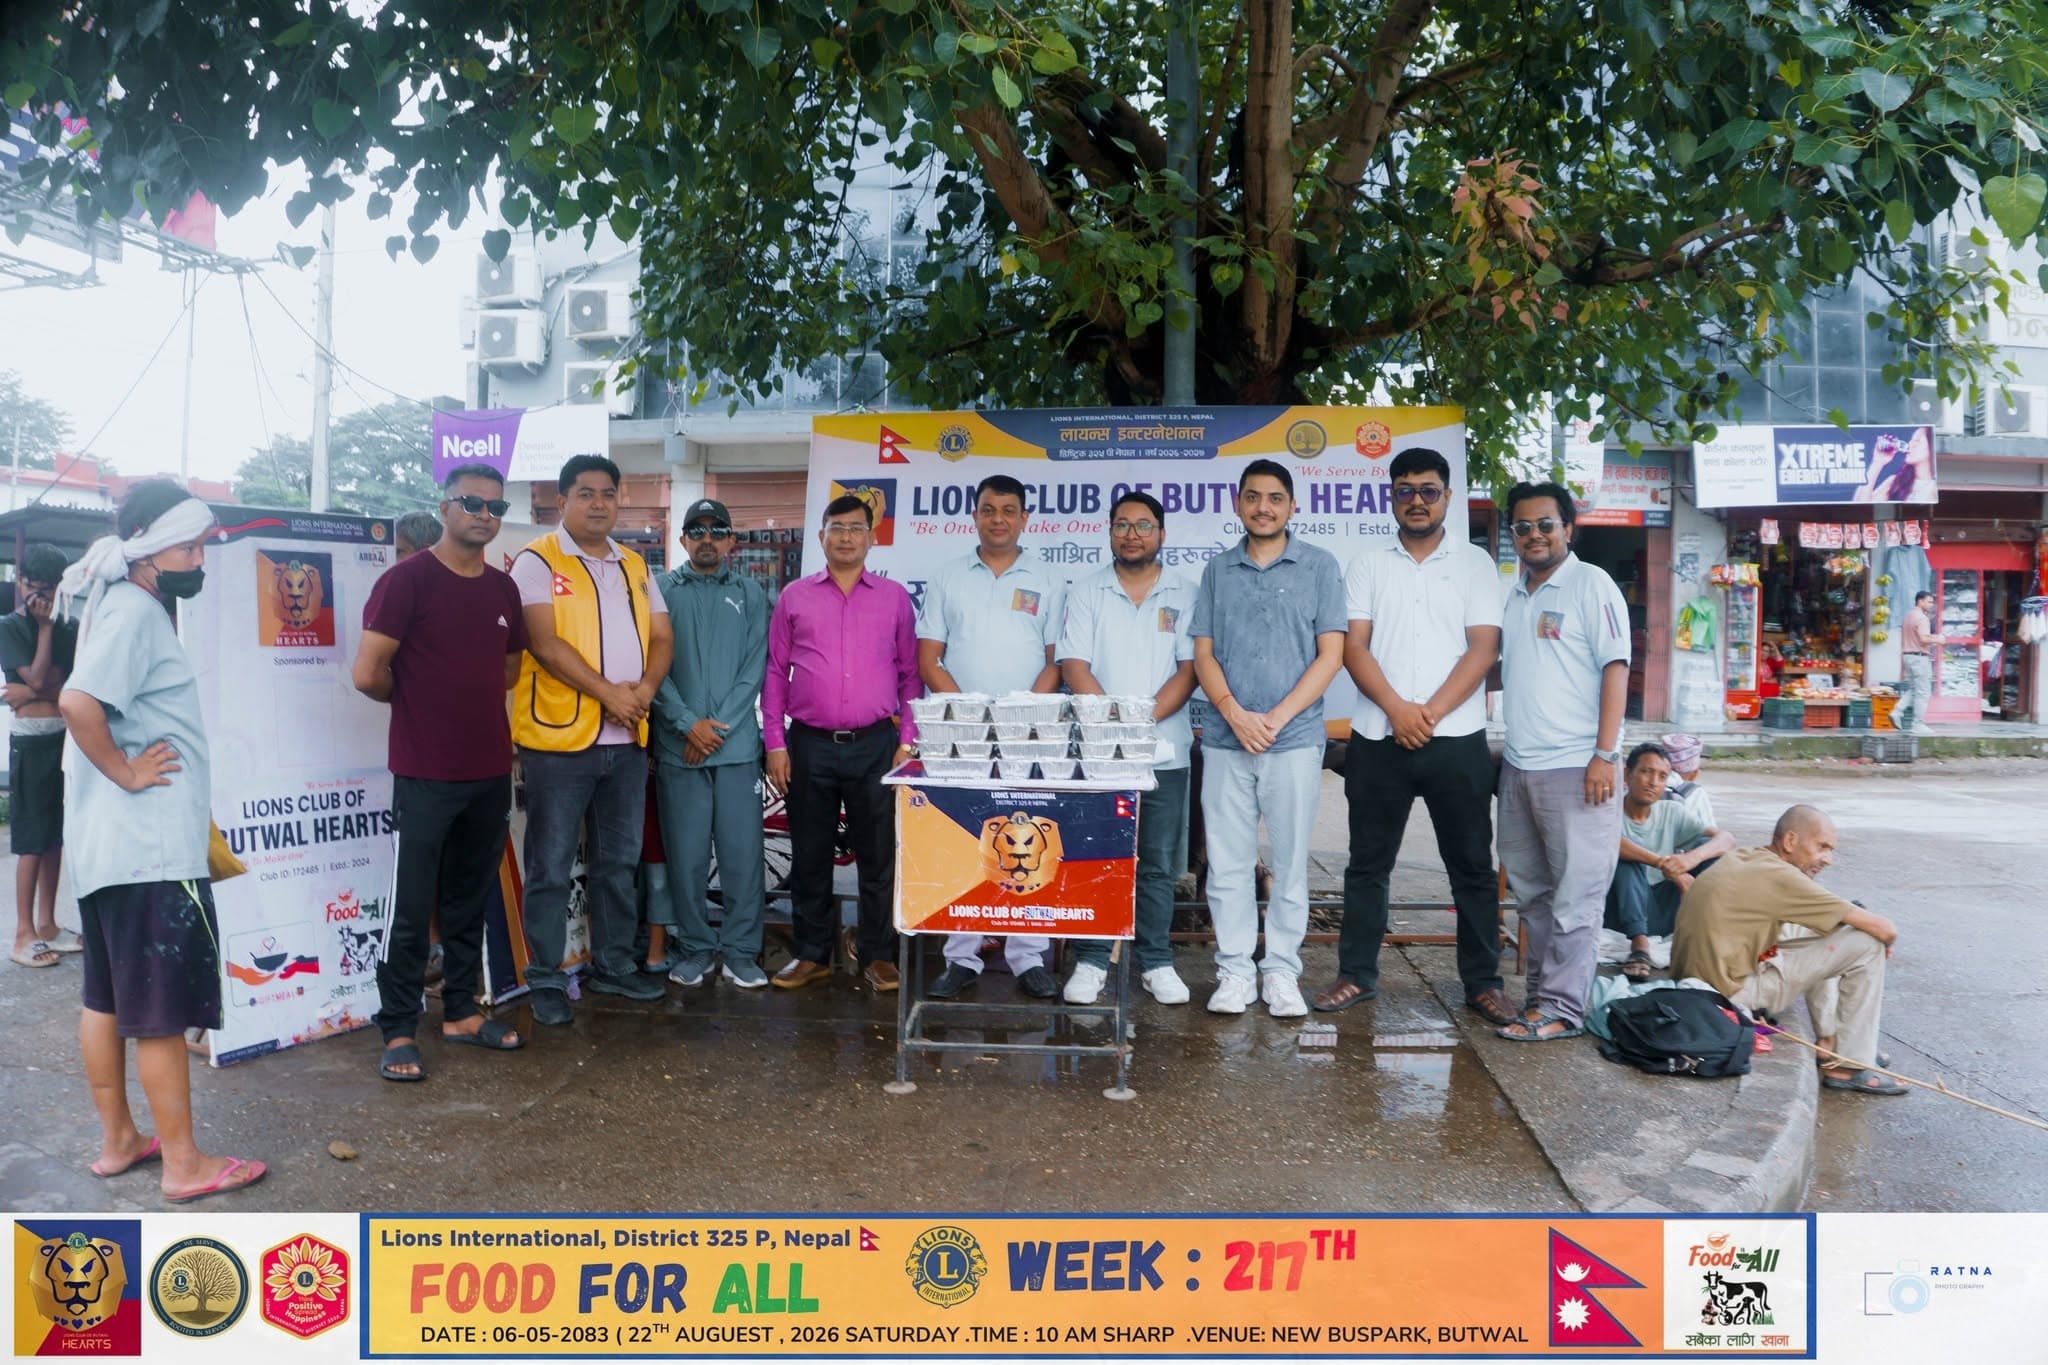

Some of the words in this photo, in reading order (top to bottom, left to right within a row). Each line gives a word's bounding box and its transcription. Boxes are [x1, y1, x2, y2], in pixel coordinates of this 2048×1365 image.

[1073, 414, 1133, 422] INTERNATIONAL,
[1134, 413, 1167, 421] DISTRICT
[1168, 413, 1181, 421] 325
[1191, 413, 1215, 421] NEPAL
[1059, 426, 1111, 442] लायन्स
[1117, 423, 1206, 442] इन्टरनेशनल
[442, 432, 501, 458] Ncell
[1777, 443, 1866, 469] XTREME
[1326, 465, 1366, 477] Serve
[1370, 465, 1389, 479] By
[1778, 468, 1827, 485] ENERGY
[912, 484, 978, 516] LION
[1022, 482, 1101, 515] CLUB
[1310, 483, 1393, 514] HEAR
[943, 519, 977, 535] One
[1021, 519, 1061, 534] ake
[1223, 522, 1249, 535] Clu
[1039, 541, 1102, 564] आश्रित
[275, 636, 320, 646] HEARTS
[273, 656, 318, 666] Sponsored
[242, 797, 294, 820] LIONS
[297, 791, 342, 813] CLUB
[344, 789, 366, 808] OF
[313, 809, 394, 844] HEARTS
[260, 870, 279, 882] Club
[326, 898, 360, 924] Food
[948, 905, 981, 918] LIONS
[981, 905, 1010, 919] CLUB
[1010, 906, 1025, 919] OF
[1054, 906, 1095, 921] HEARTS
